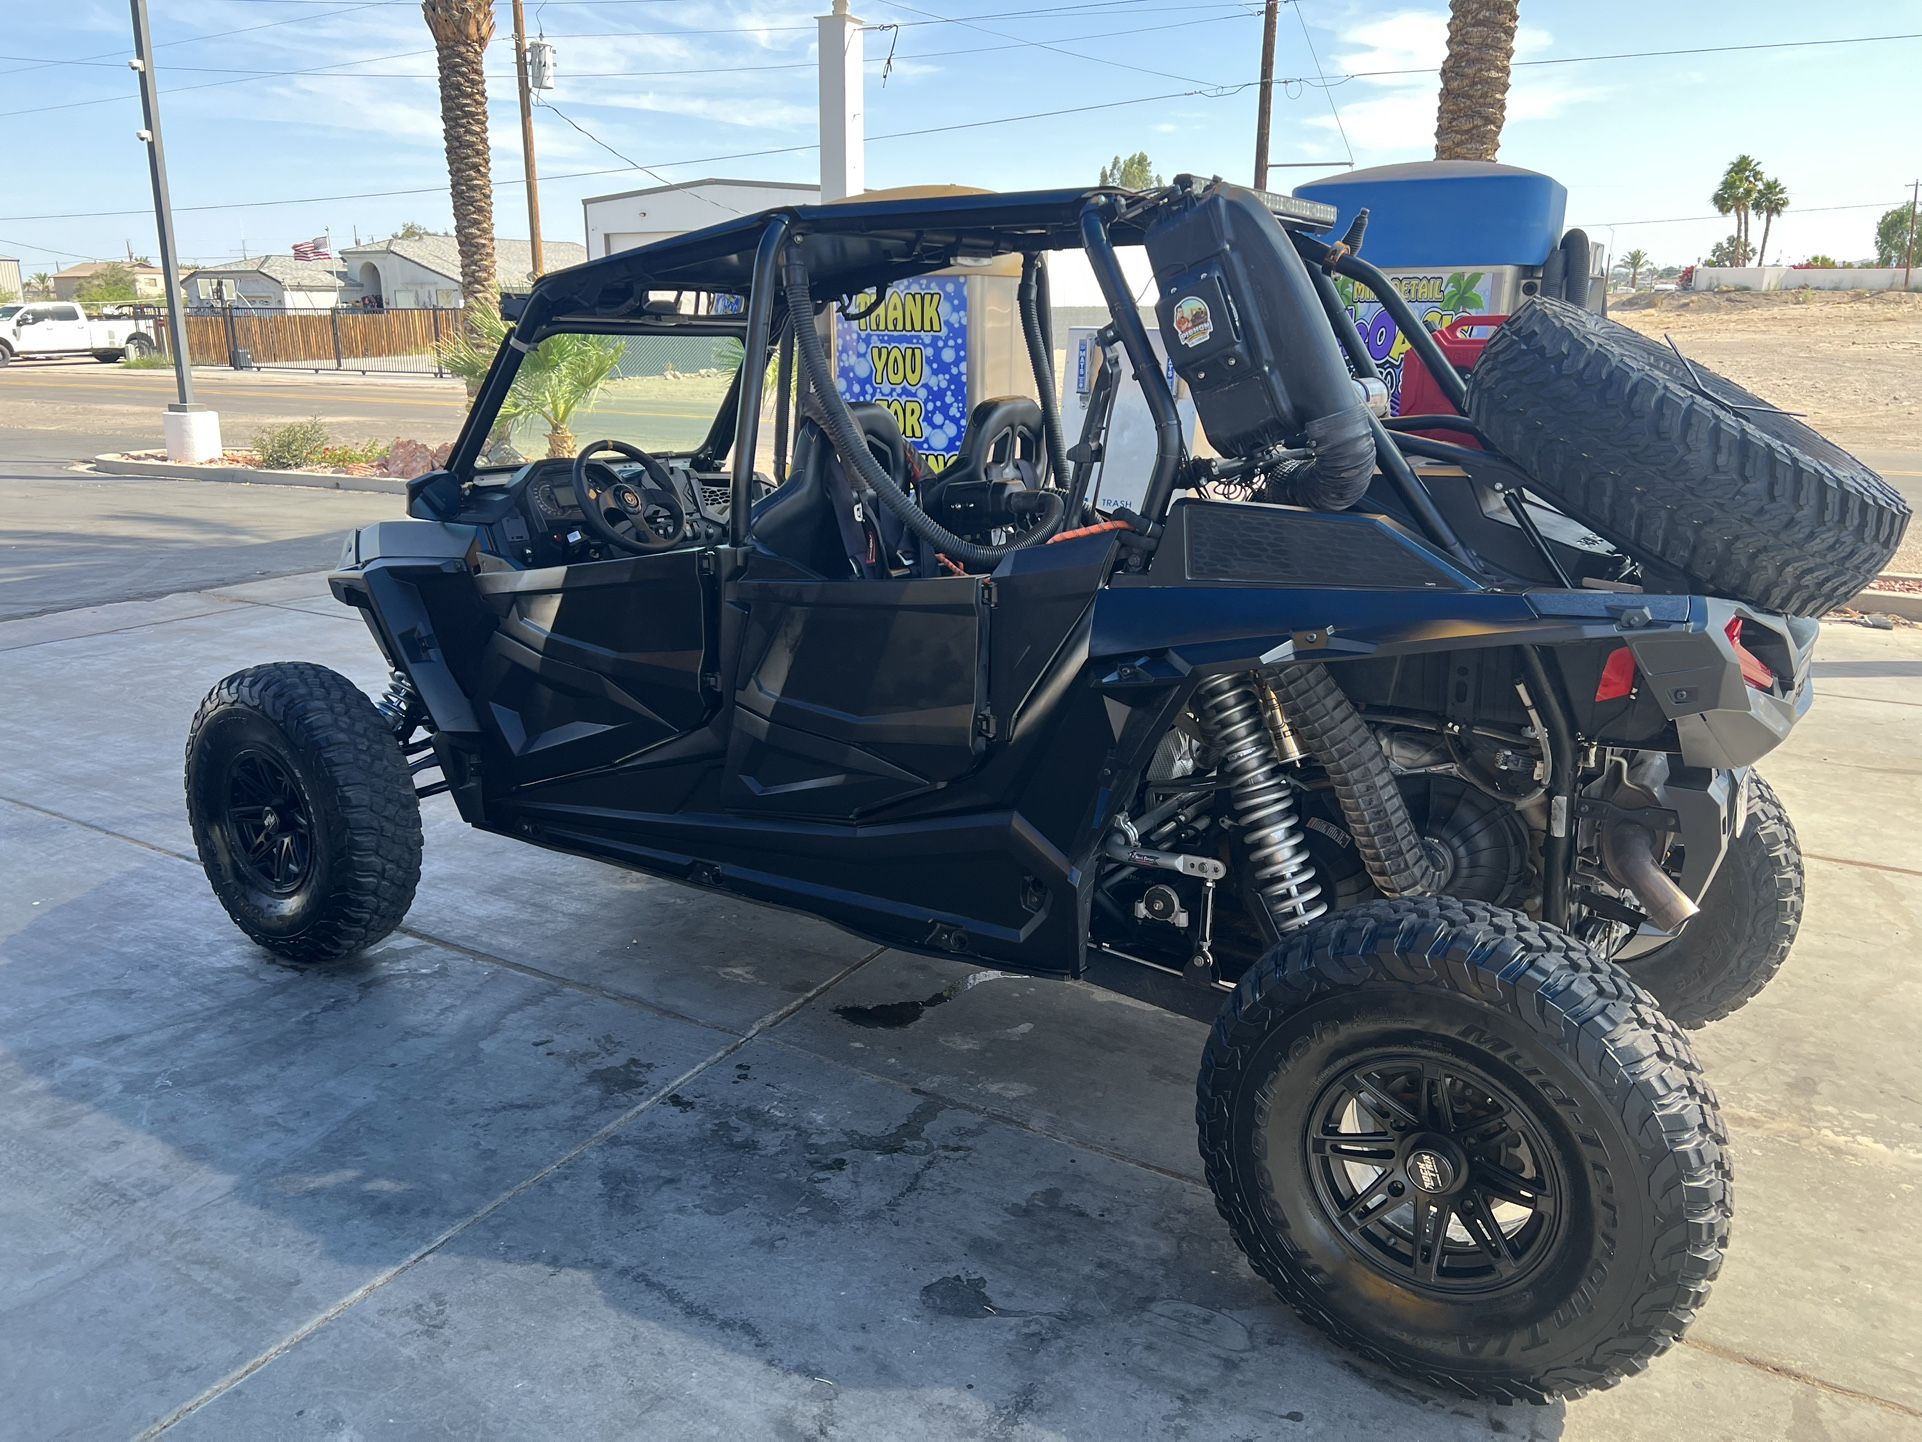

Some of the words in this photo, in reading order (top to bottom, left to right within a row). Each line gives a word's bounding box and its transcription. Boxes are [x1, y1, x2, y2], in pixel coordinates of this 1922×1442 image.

[856, 290, 942, 332] THANK
[871, 346, 924, 386] YOU
[874, 399, 924, 438] OR
[1102, 498, 1132, 508] TRASH
[1416, 1161, 1434, 1190] ROCK
